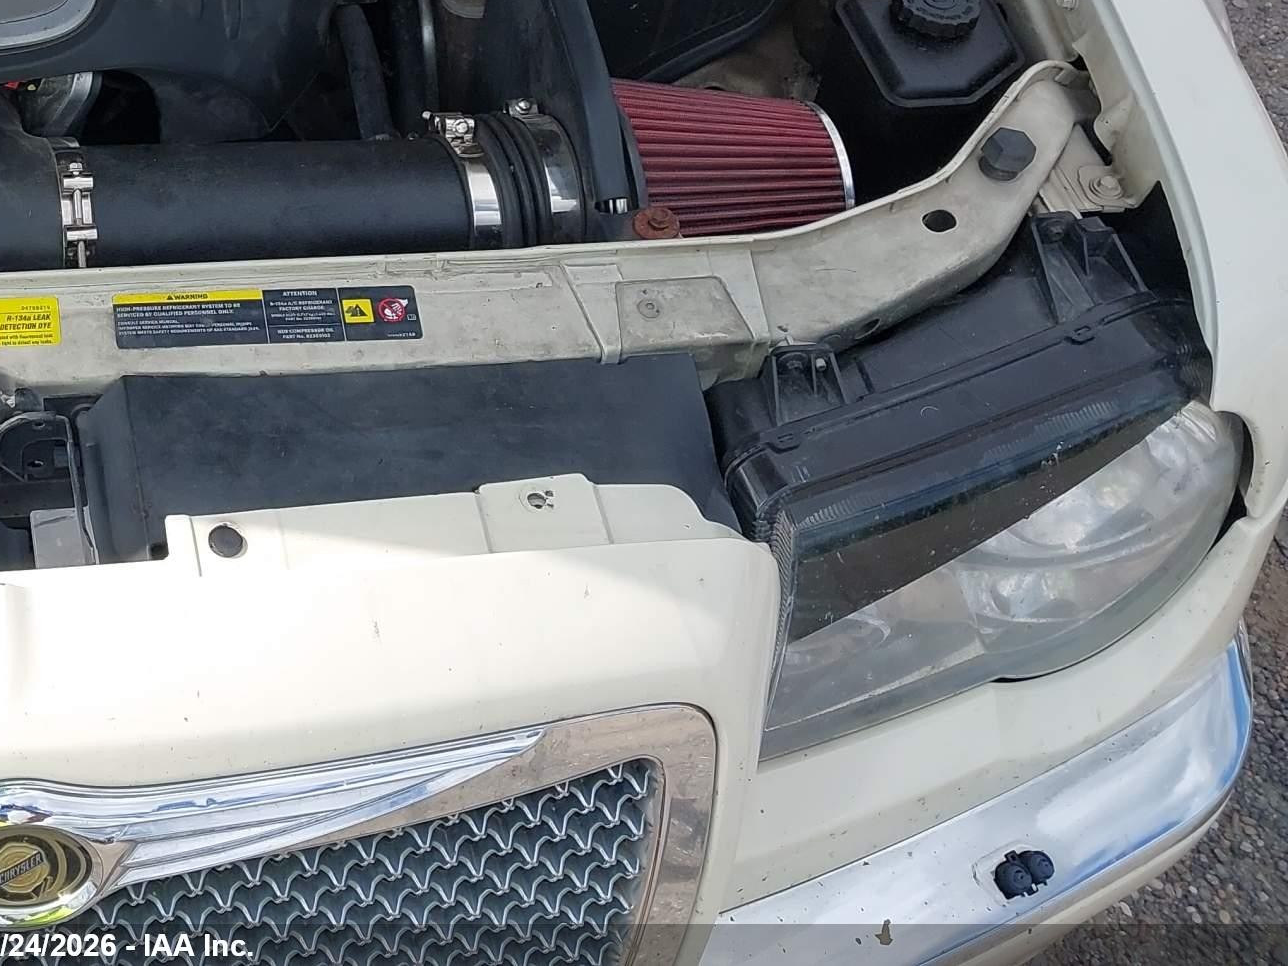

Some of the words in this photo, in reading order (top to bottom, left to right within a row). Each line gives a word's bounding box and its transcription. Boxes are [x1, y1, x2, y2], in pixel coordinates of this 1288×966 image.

[7, 314, 32, 322] R-134a
[32, 313, 52, 321] LEAK
[0, 322, 37, 331] DETECTION
[38, 321, 52, 329] DYE
